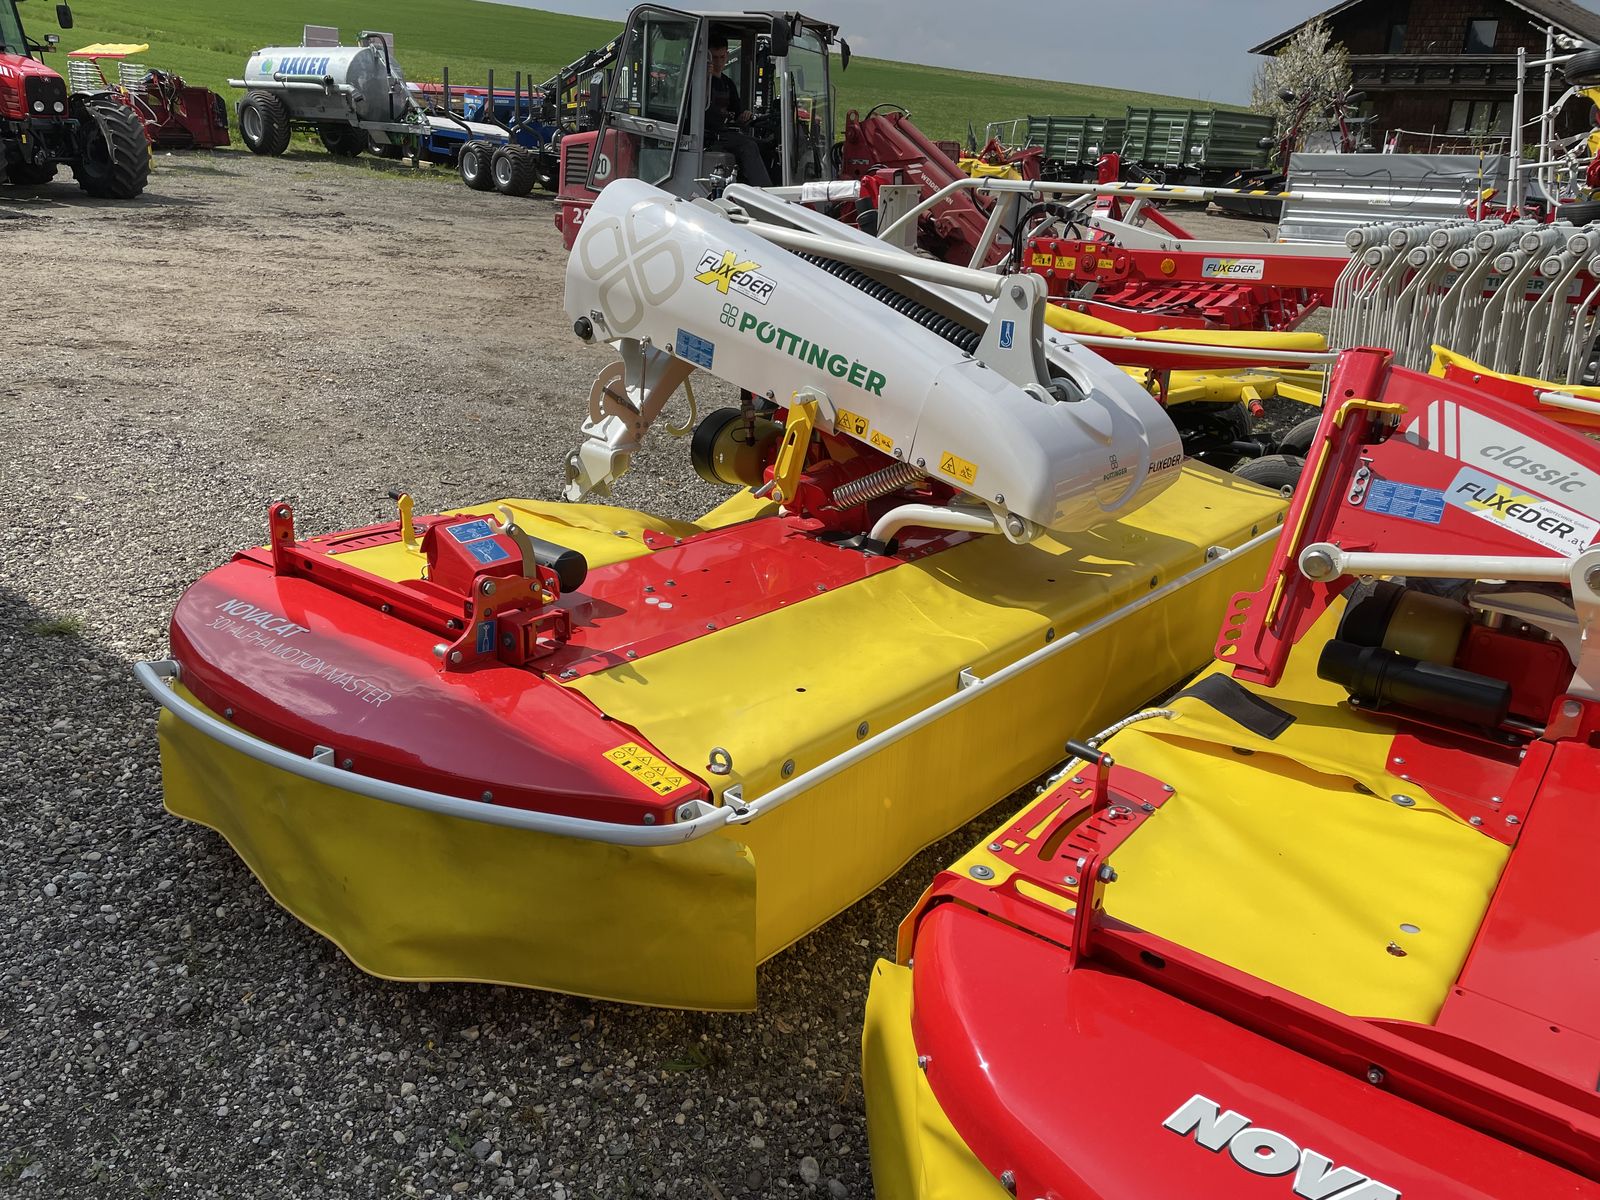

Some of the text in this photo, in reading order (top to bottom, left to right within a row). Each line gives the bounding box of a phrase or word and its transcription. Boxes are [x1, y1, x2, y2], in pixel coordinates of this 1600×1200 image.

[278, 57, 330, 75] BAUER
[700, 255, 774, 298] FLIXEDER
[1206, 263, 1255, 274] FLIXEDER
[1148, 454, 1181, 474] FLIXEDER
[1480, 445, 1587, 493] classic
[1456, 482, 1575, 539] FLIXEDER
[215, 598, 312, 638] NOVACAT
[268, 642, 331, 675] MOTION
[322, 667, 392, 708] MASTER
